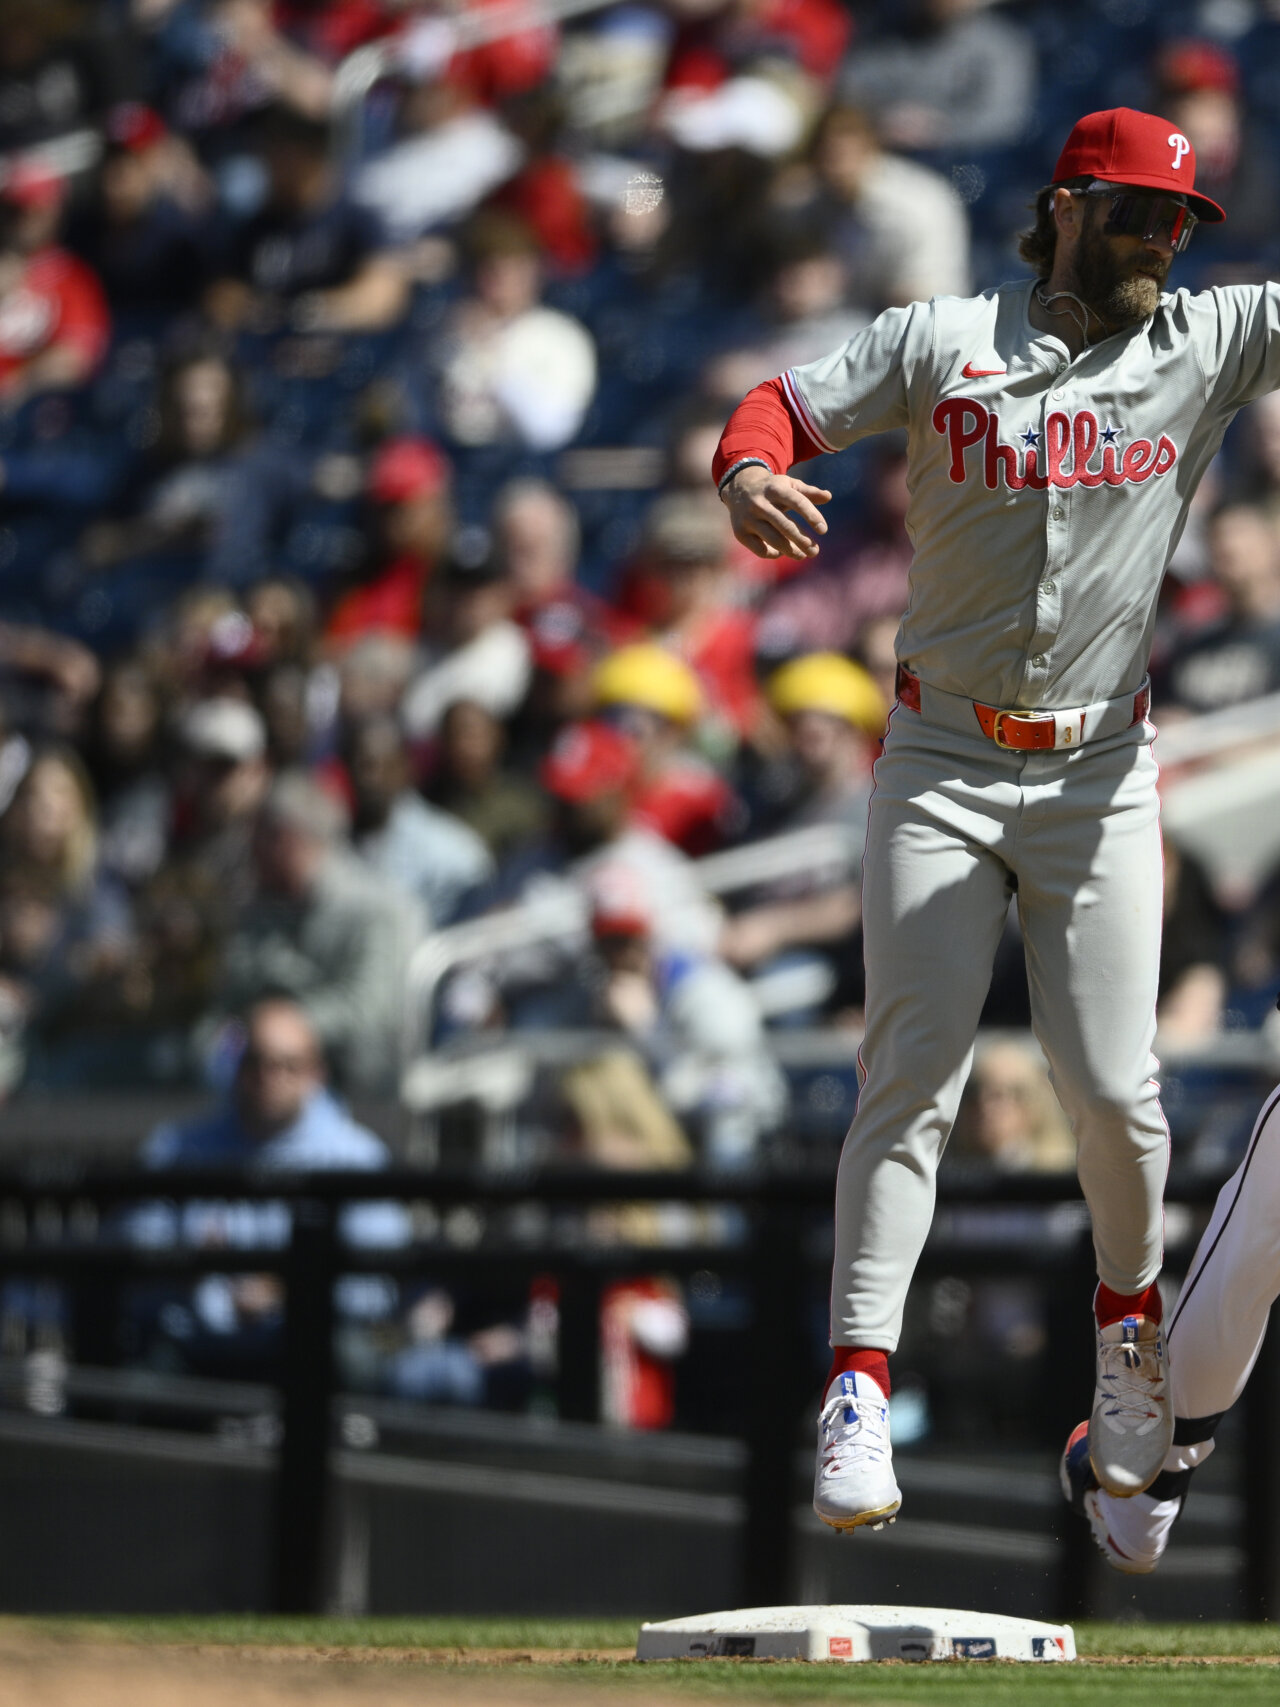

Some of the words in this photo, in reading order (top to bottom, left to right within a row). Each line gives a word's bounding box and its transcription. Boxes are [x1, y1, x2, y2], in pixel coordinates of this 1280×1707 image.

[1167, 133, 1190, 170] P
[932, 397, 1178, 490] Phillies
[1064, 726, 1072, 743] 3
